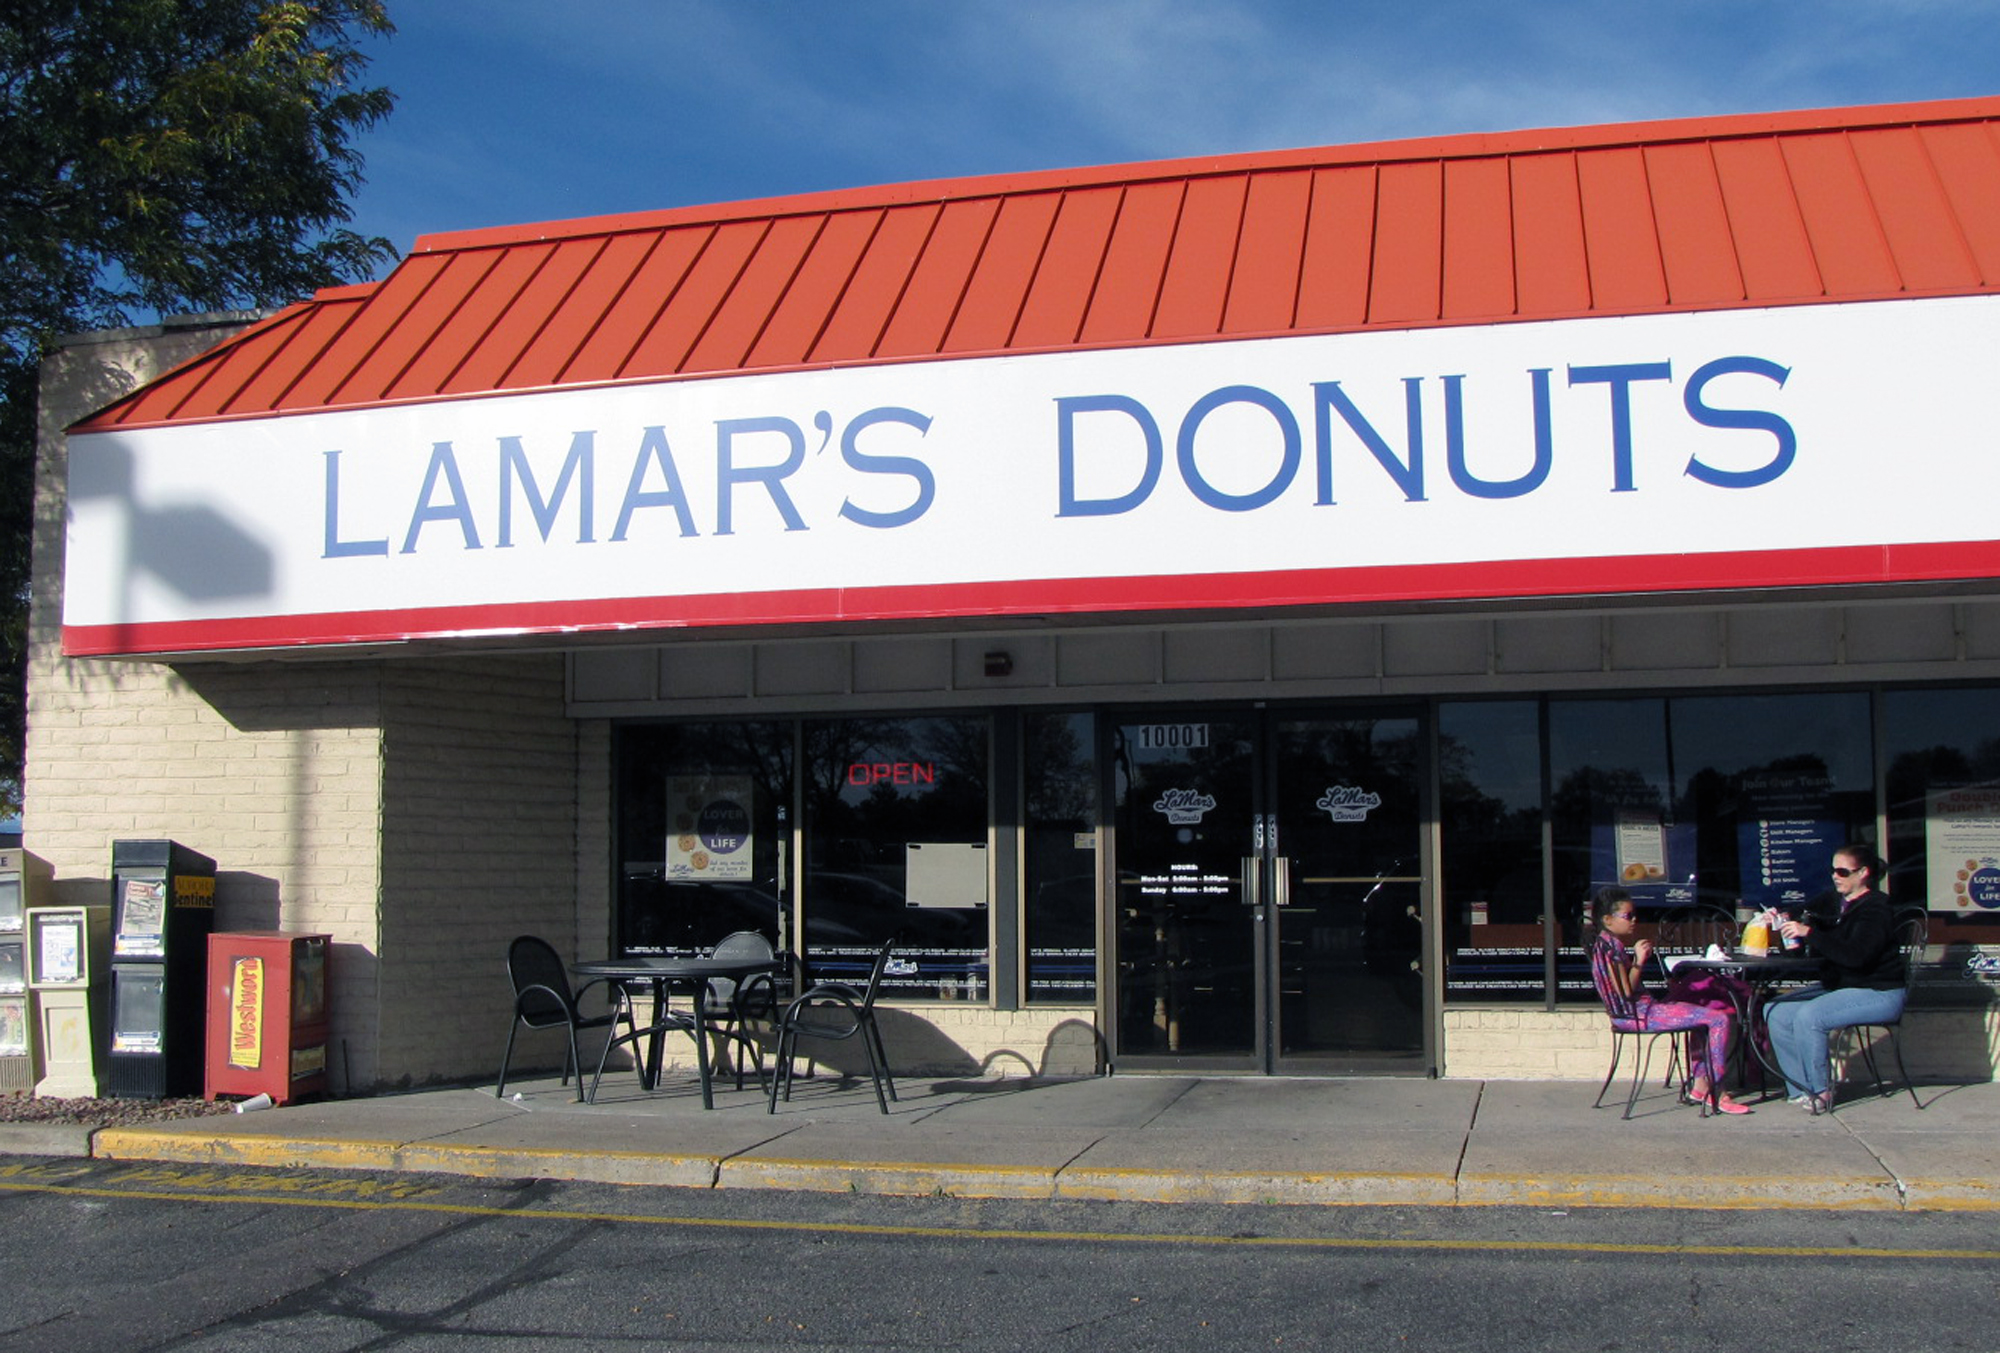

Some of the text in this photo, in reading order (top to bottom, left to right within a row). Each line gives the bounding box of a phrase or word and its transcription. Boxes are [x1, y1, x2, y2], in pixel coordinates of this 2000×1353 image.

[320, 355, 1798, 560] LAMAR'S DONUTS
[1141, 725, 1206, 747] 10001
[848, 762, 934, 786] OPEN
[1155, 789, 1214, 811] LaMar's
[1318, 786, 1379, 808] LaMar's
[704, 809, 744, 820] LOVER
[710, 838, 737, 849] LIFE
